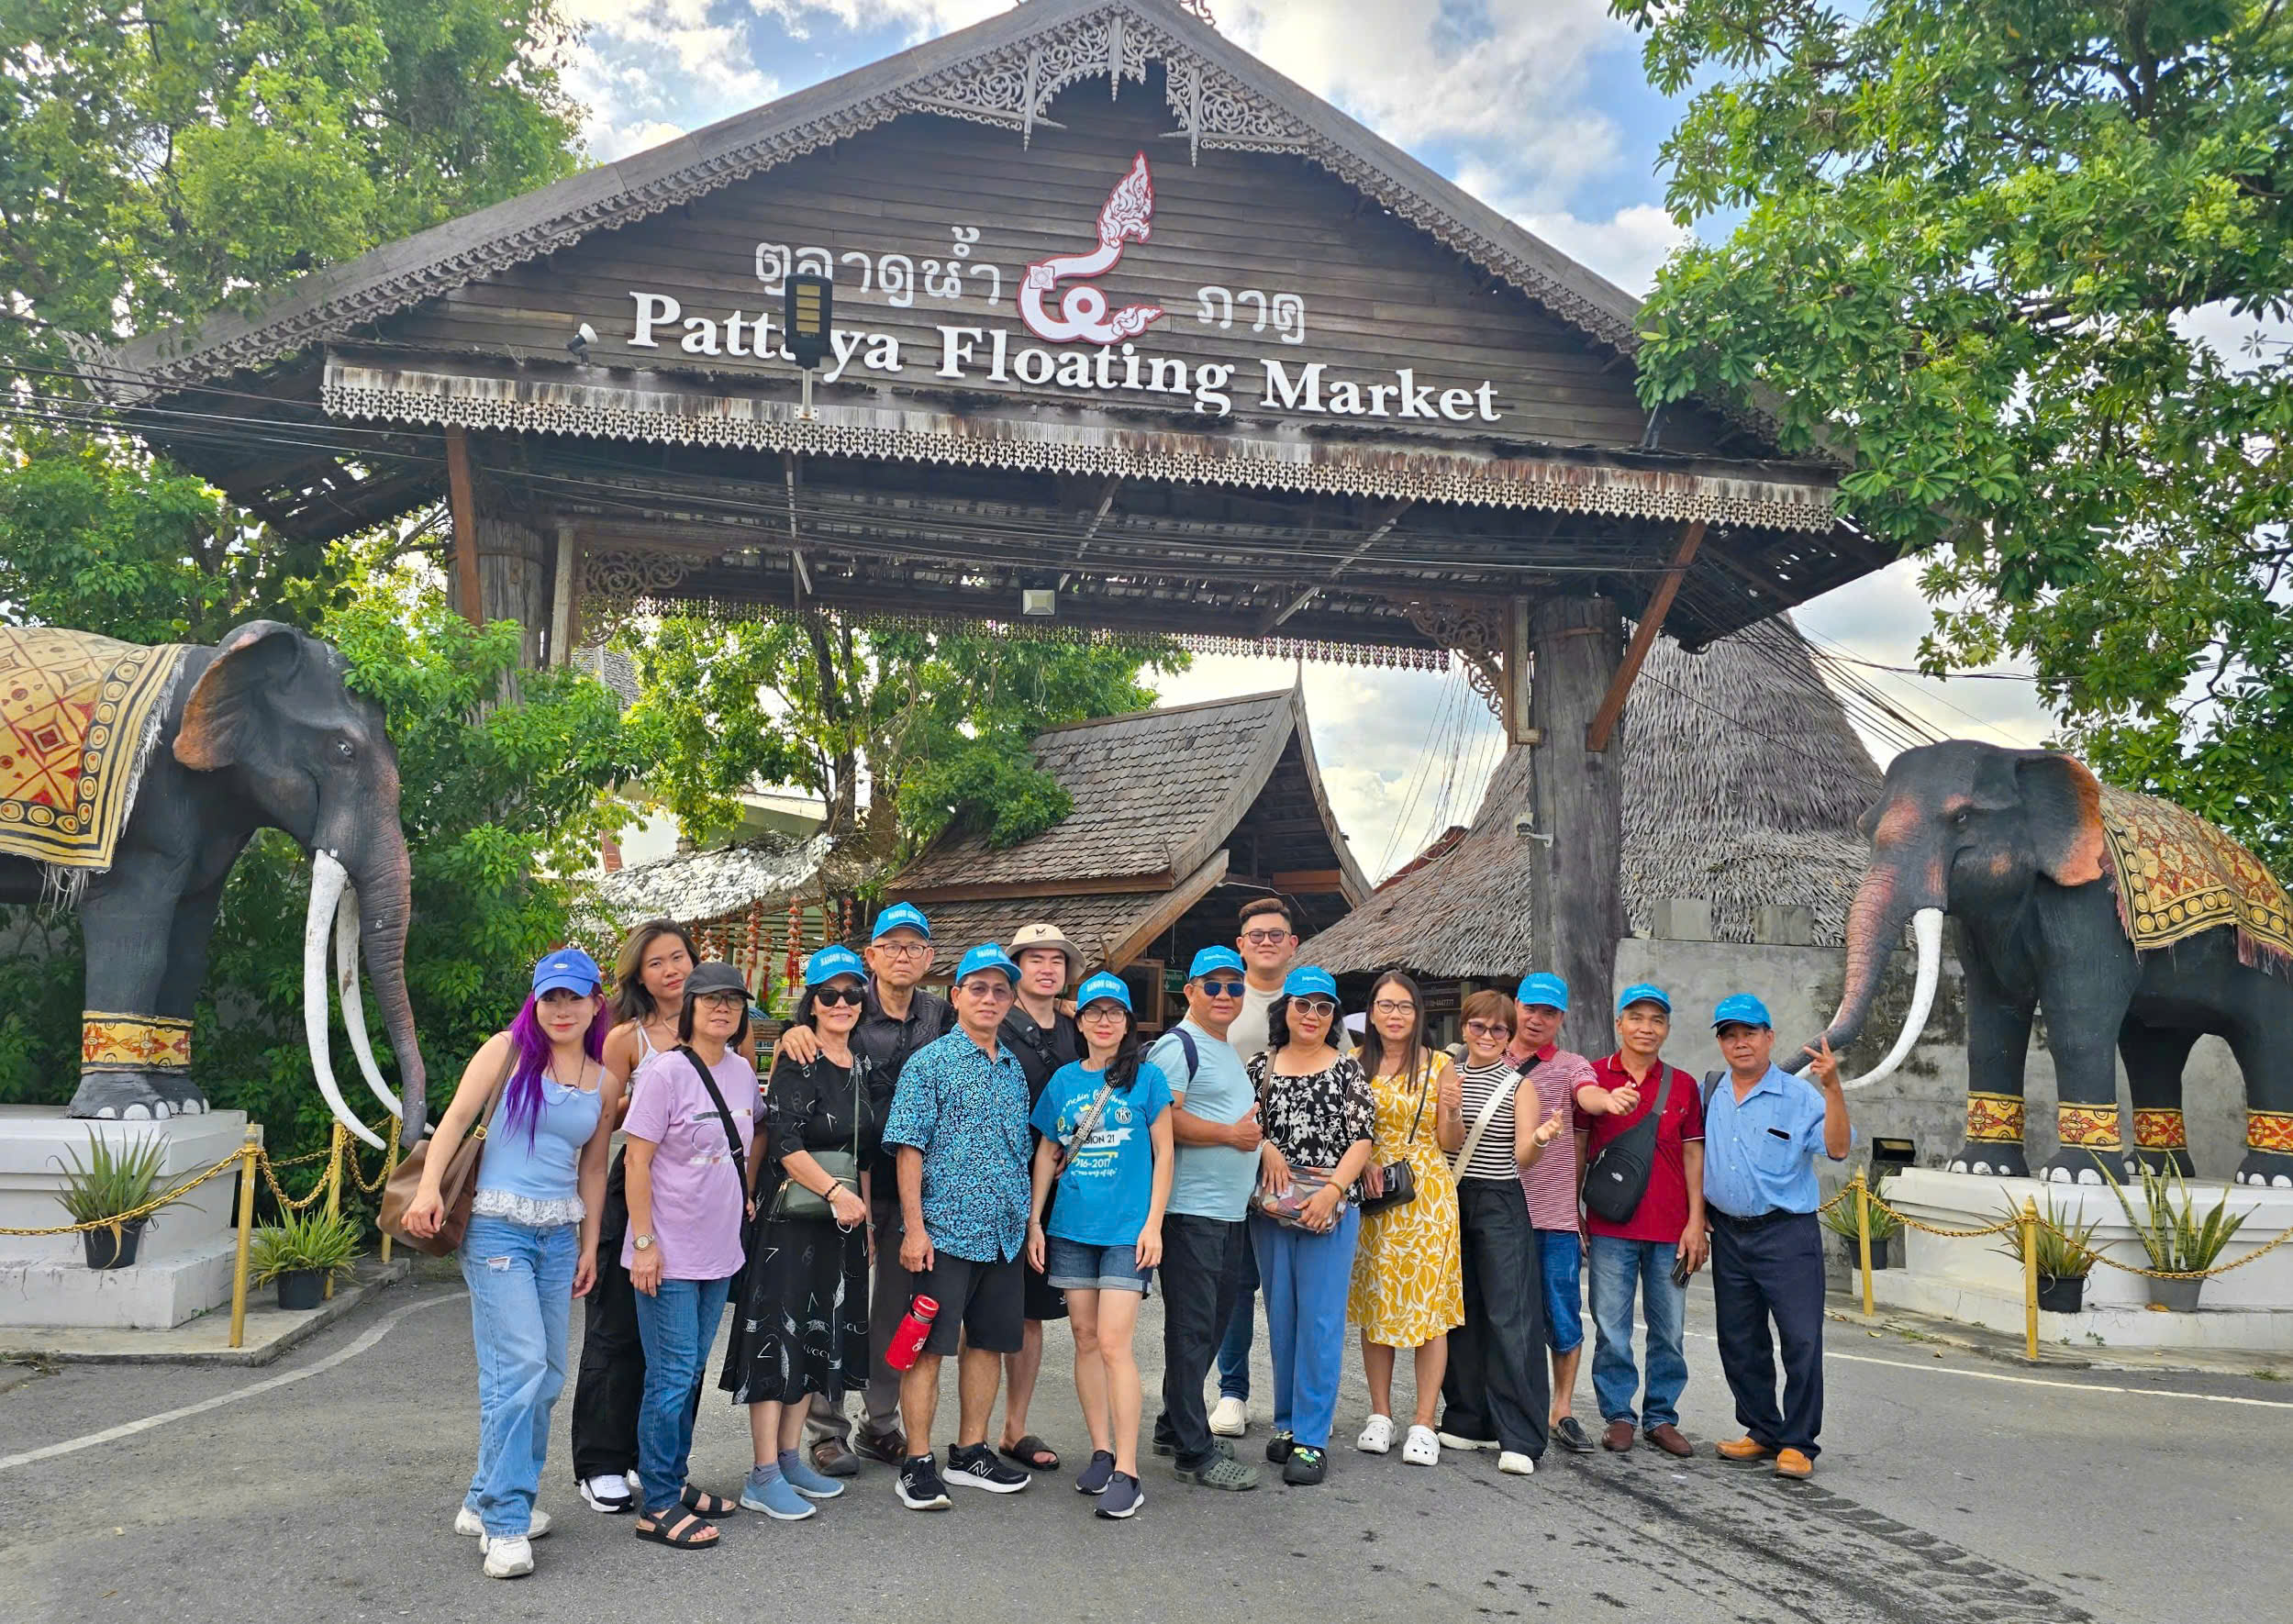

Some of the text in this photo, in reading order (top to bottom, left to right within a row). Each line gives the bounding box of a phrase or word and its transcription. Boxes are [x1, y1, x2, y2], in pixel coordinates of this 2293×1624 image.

[627, 291, 1502, 421] Pattya Floating Market
[1108, 1135, 1115, 1143] 21
